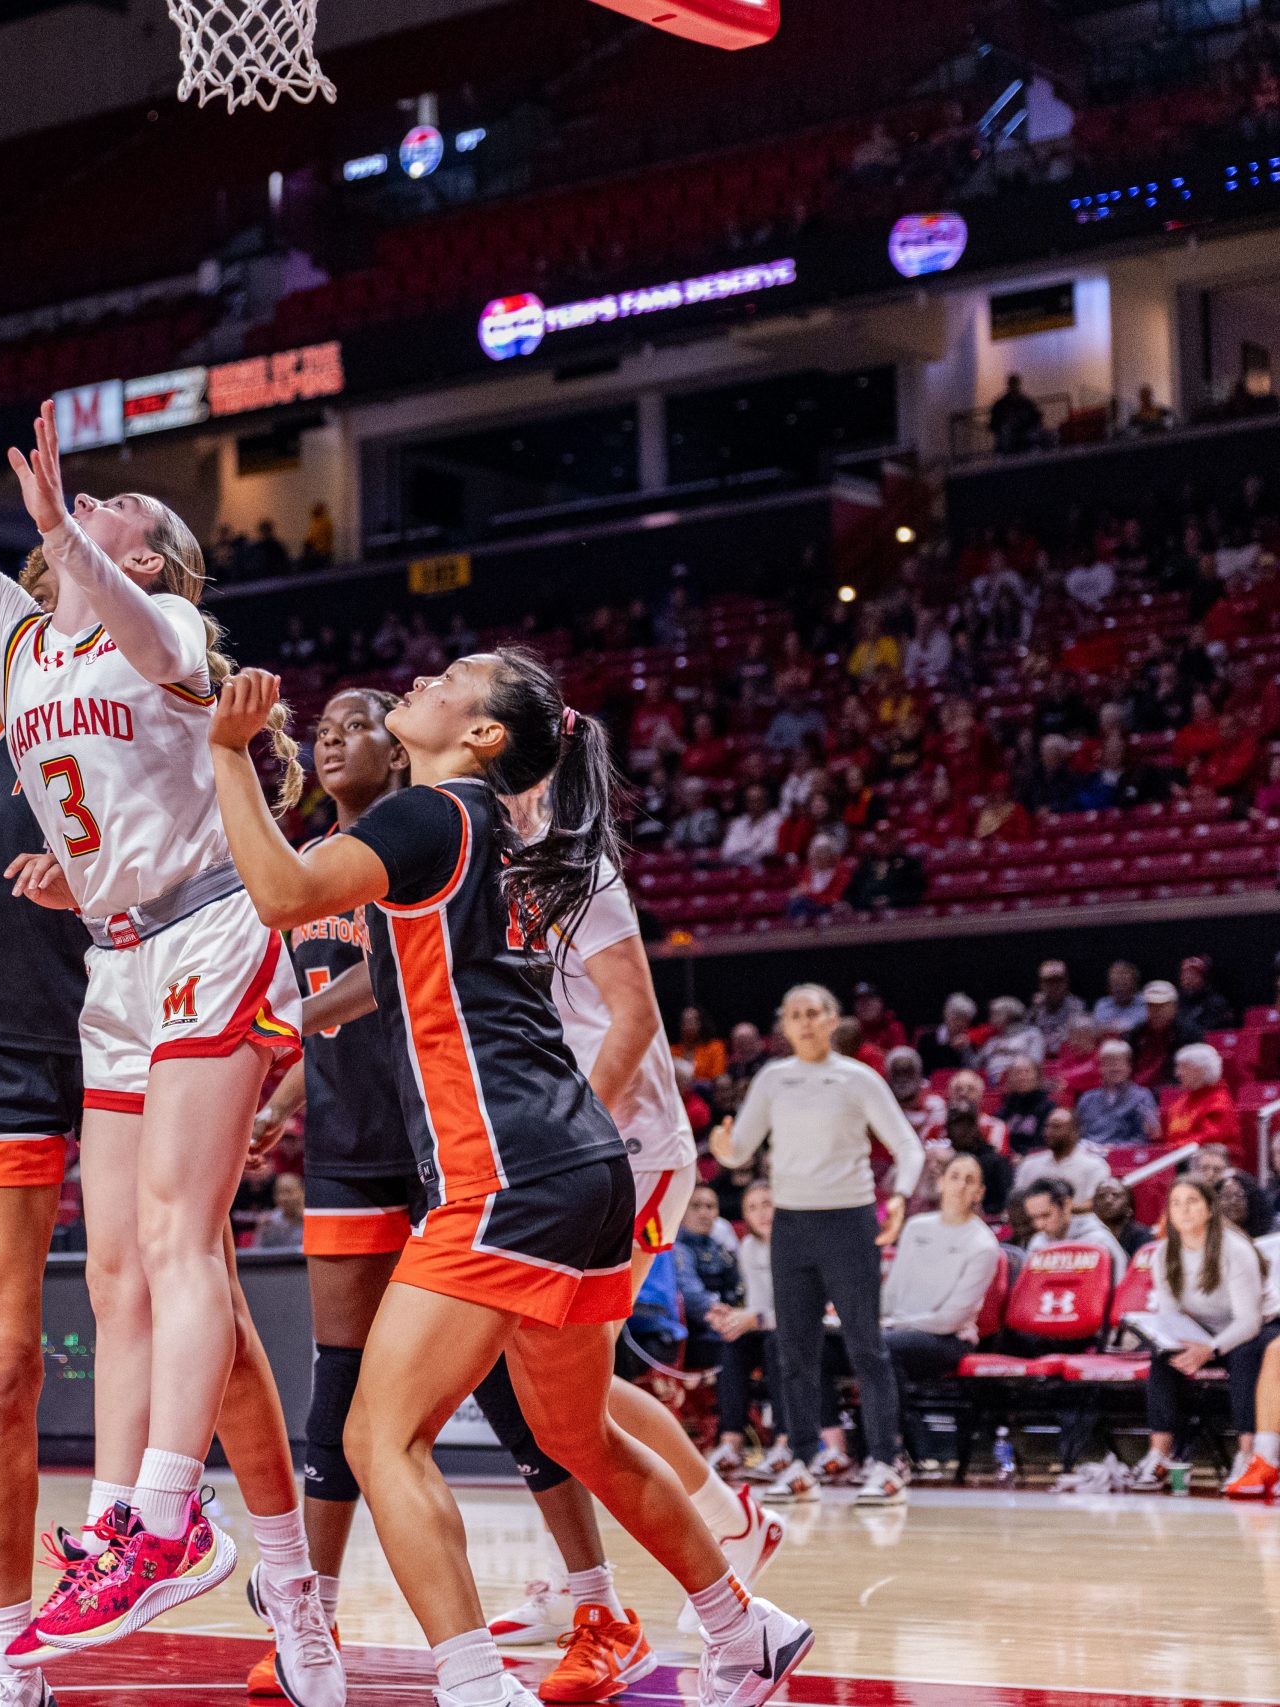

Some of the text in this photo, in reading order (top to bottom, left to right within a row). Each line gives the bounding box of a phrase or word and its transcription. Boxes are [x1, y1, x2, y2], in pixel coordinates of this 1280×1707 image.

[619, 280, 683, 318] FANS
[683, 257, 797, 305] DESERVE
[39, 755, 102, 858] 3
[163, 975, 201, 1022] M
